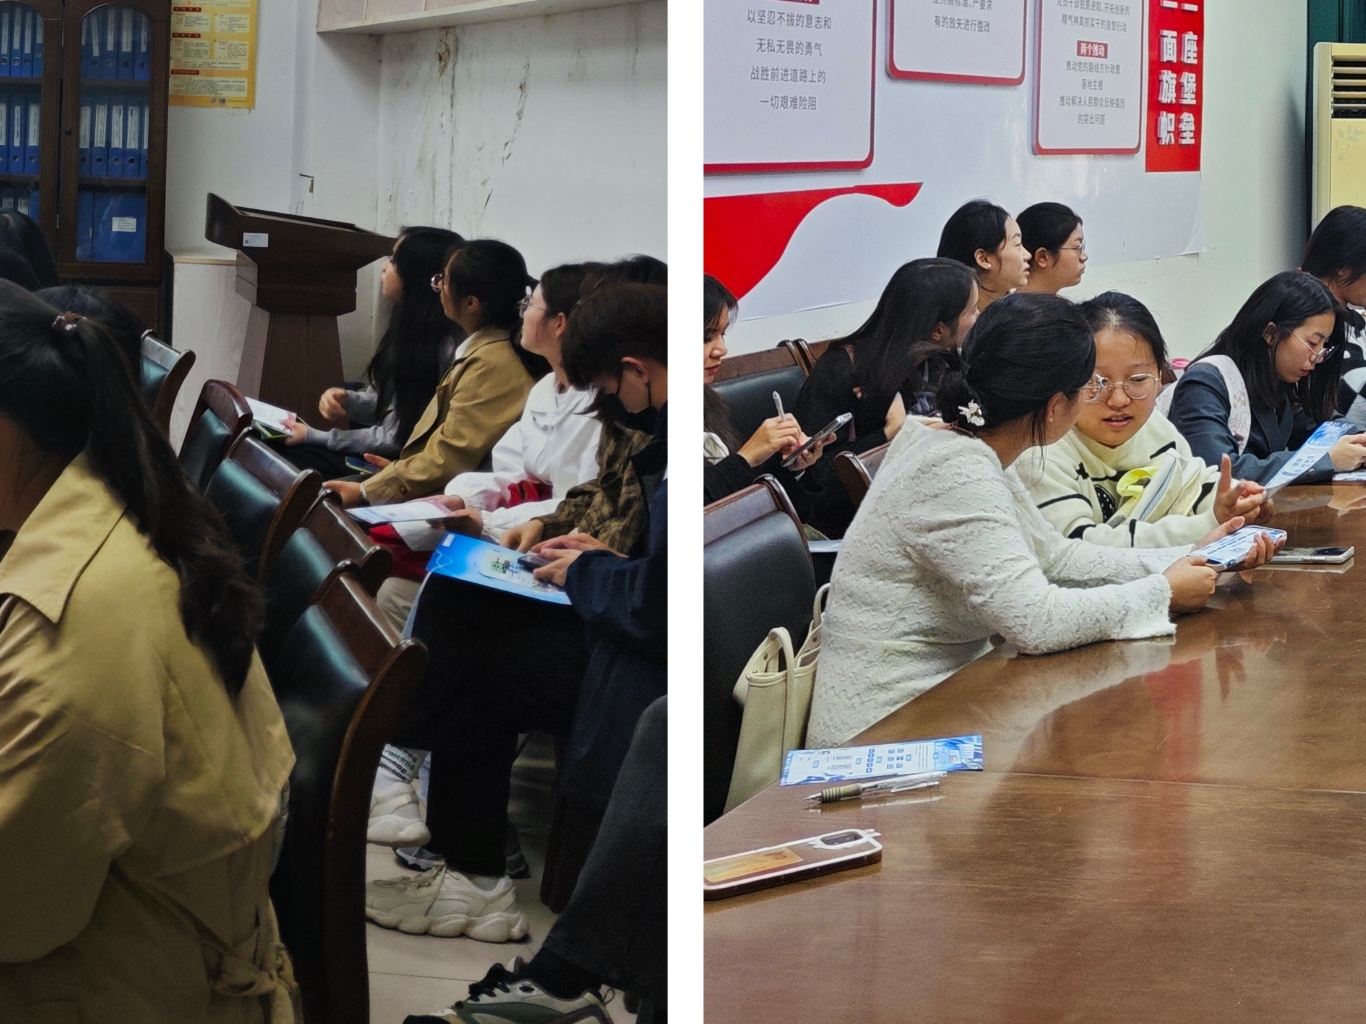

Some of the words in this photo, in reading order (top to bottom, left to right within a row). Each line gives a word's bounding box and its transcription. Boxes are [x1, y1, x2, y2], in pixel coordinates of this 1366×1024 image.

[747, 8, 832, 30] 以坚忍不拔的意志和
[934, 15, 991, 33] 有的放矢进行整改
[756, 38, 822, 57] 无私无畏的勇气
[1080, 43, 1105, 58] 两个推动
[750, 66, 826, 84] 战胜前进道路上的
[1066, 60, 1121, 75] 推动党的路线方针政策
[1157, 0, 1178, 145] 一面旗帜
[1178, 2, 1199, 145] 一座堡垒
[760, 95, 817, 110] 一切艰难险阻
